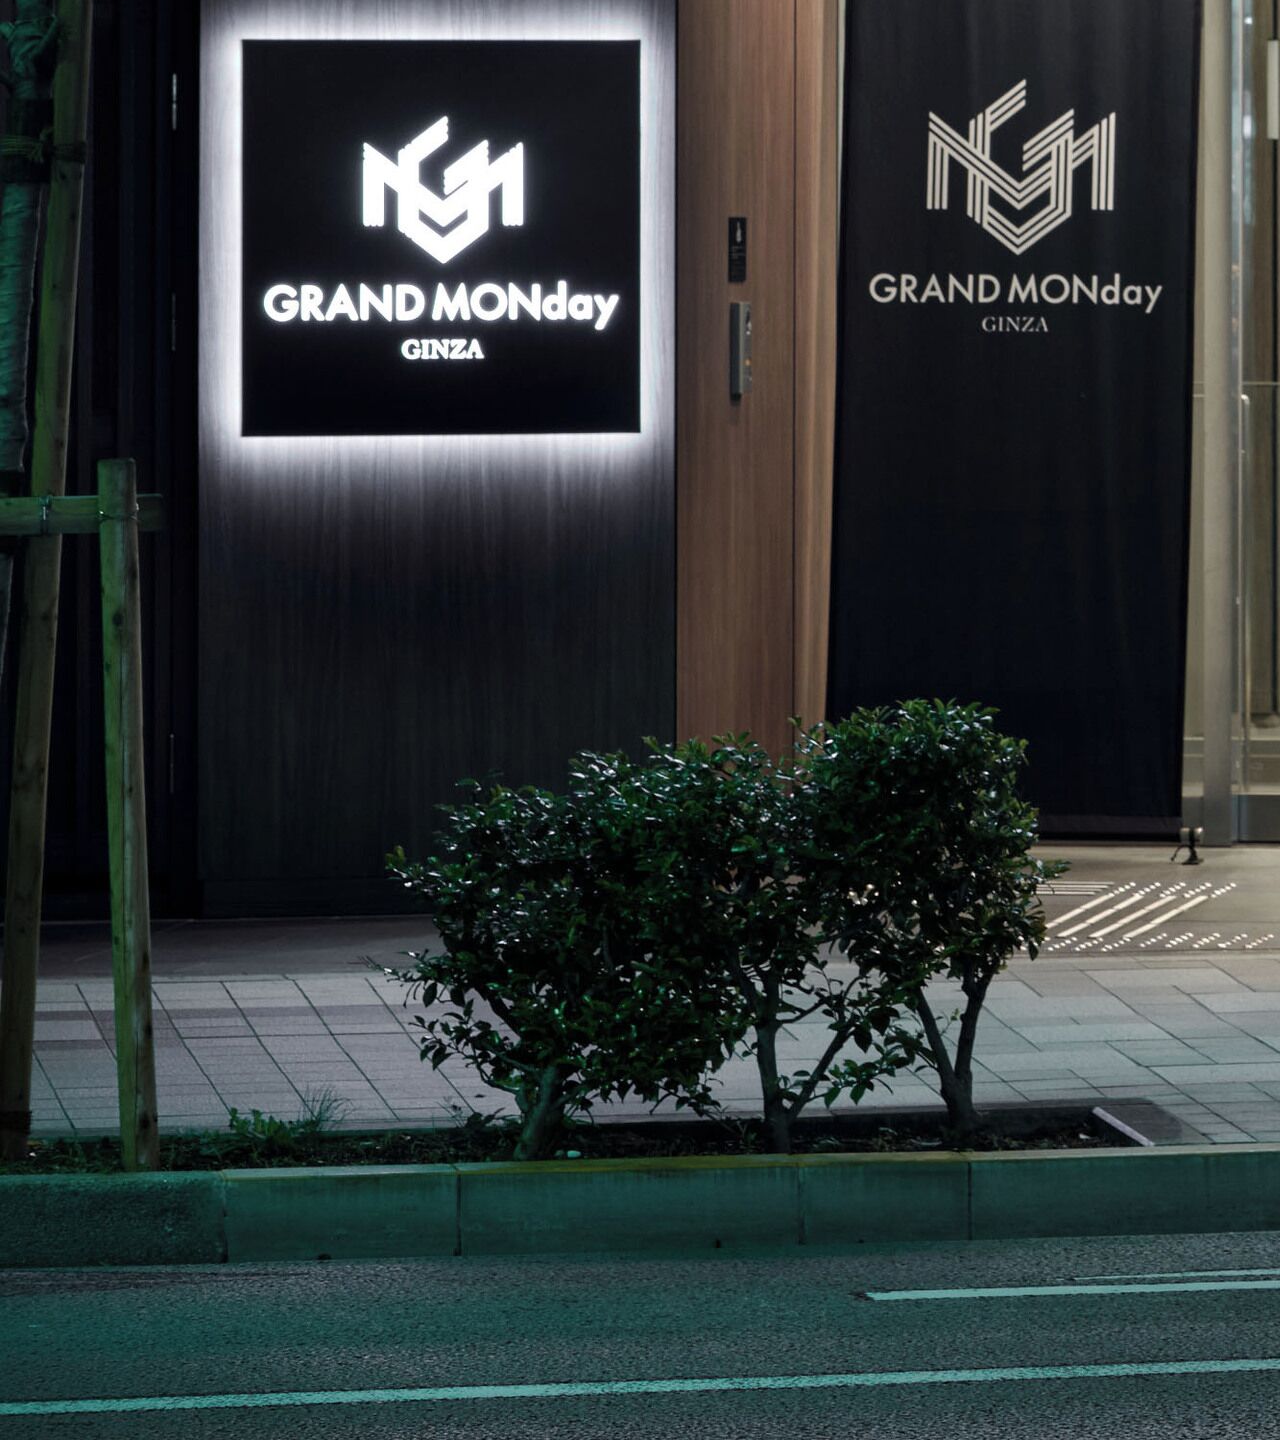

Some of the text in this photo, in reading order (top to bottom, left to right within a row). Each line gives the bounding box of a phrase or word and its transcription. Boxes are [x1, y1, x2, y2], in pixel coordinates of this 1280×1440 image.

[264, 280, 619, 330] GRAND MONday
[869, 273, 1163, 314] GRAND MONday
[981, 316, 1049, 332] GINZA
[401, 338, 484, 361] GINZA
